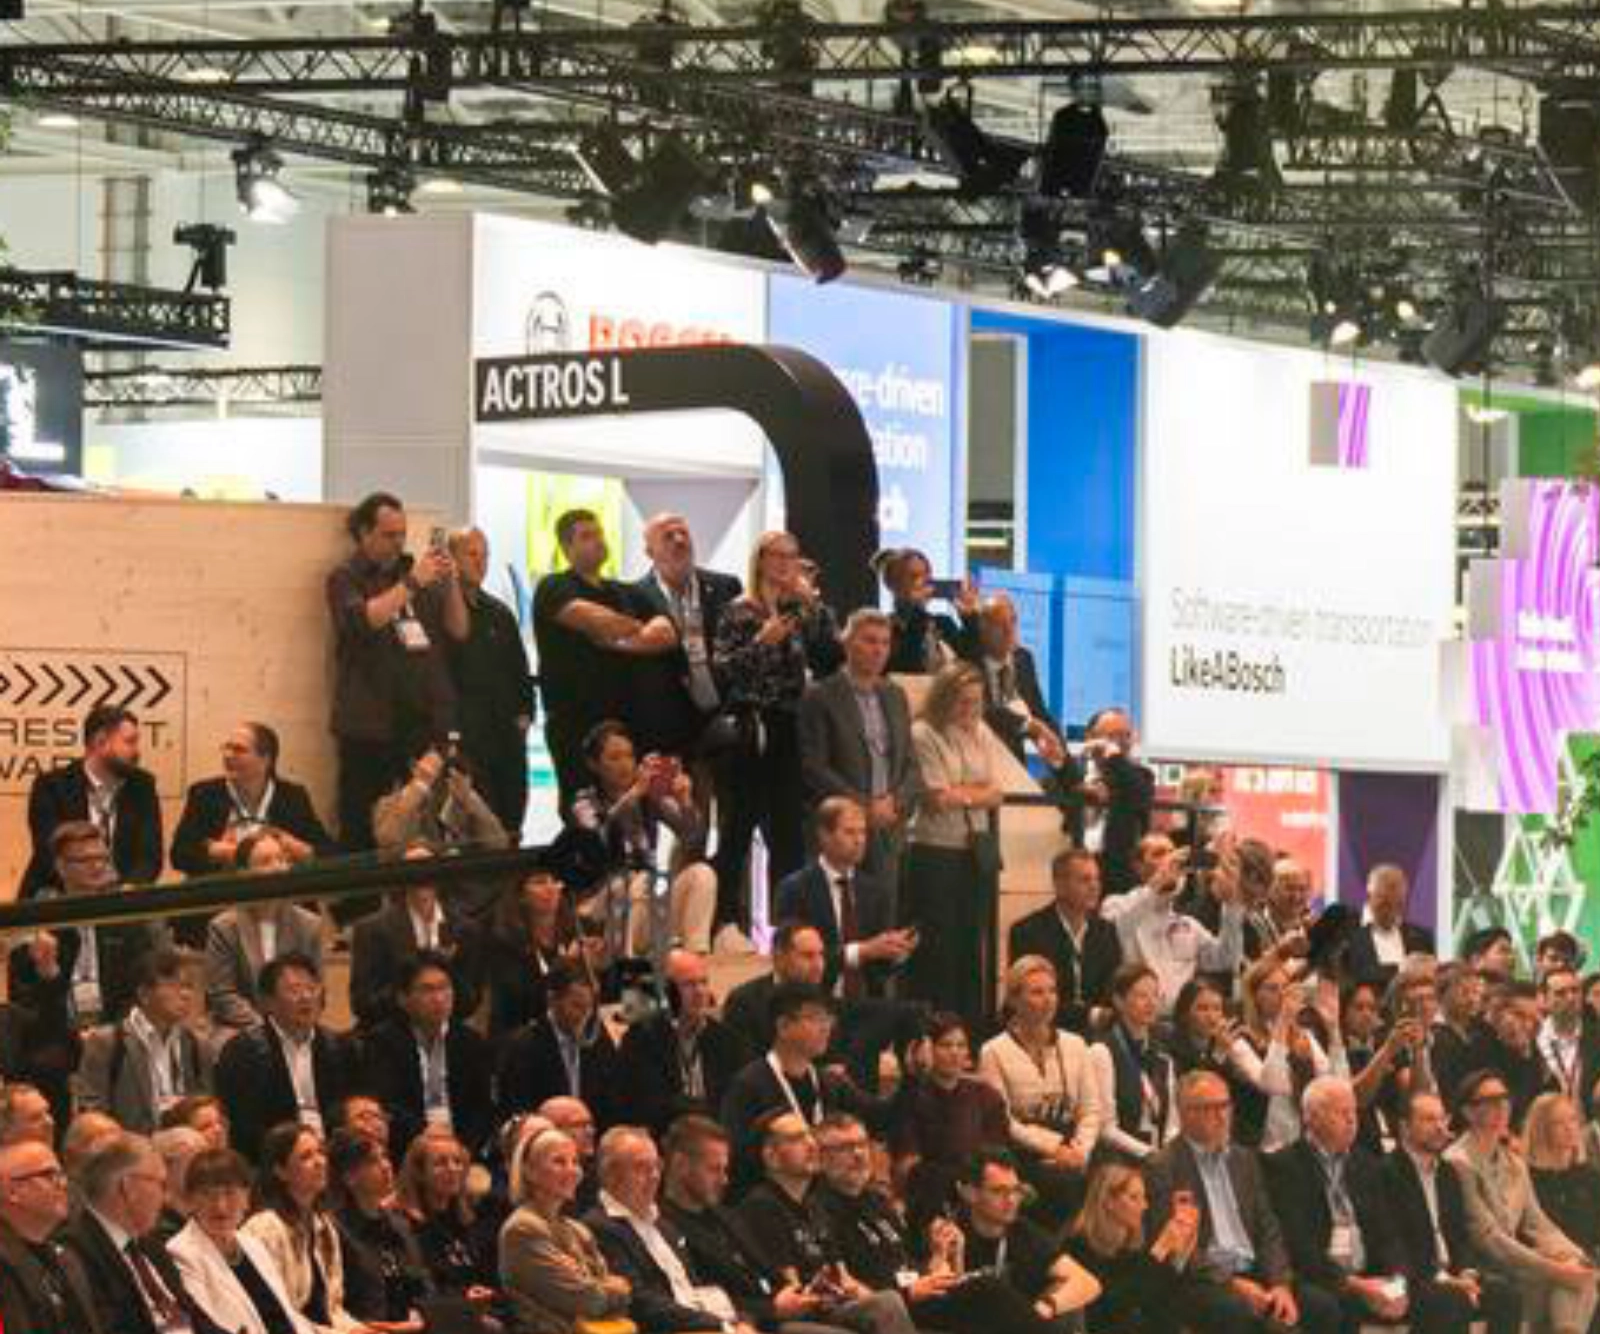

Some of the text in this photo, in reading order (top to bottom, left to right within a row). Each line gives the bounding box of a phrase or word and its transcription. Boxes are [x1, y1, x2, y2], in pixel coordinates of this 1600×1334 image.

[482, 358, 630, 412] ACTROS L
[1170, 643, 1286, 695] LikeABosch
[0, 717, 174, 749] REST.
